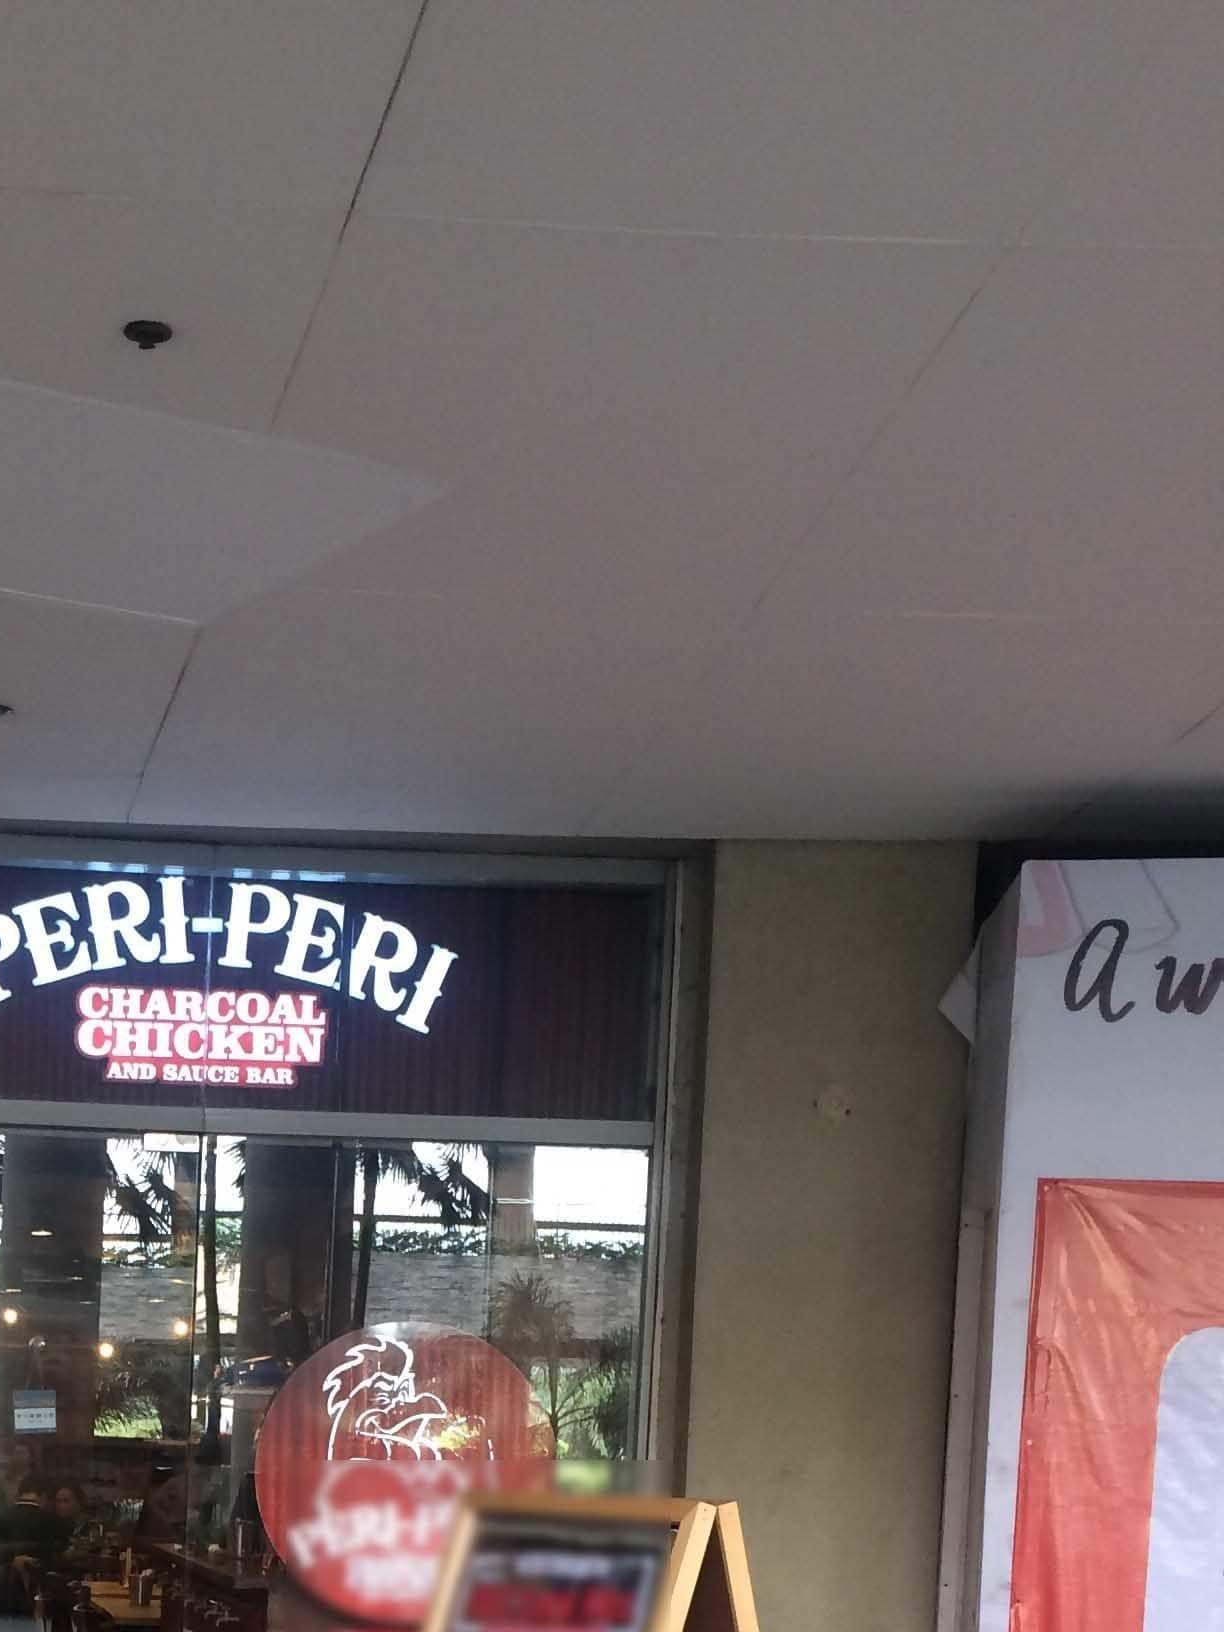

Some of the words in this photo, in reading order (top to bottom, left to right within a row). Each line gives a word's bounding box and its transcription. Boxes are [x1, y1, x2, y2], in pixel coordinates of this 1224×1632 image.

[78, 986, 327, 1026] CHARCOAL
[77, 1019, 326, 1063] CHICKEN
[106, 1062, 157, 1081] AND
[162, 1063, 240, 1084] SAUCE
[245, 1066, 294, 1085] BAR
